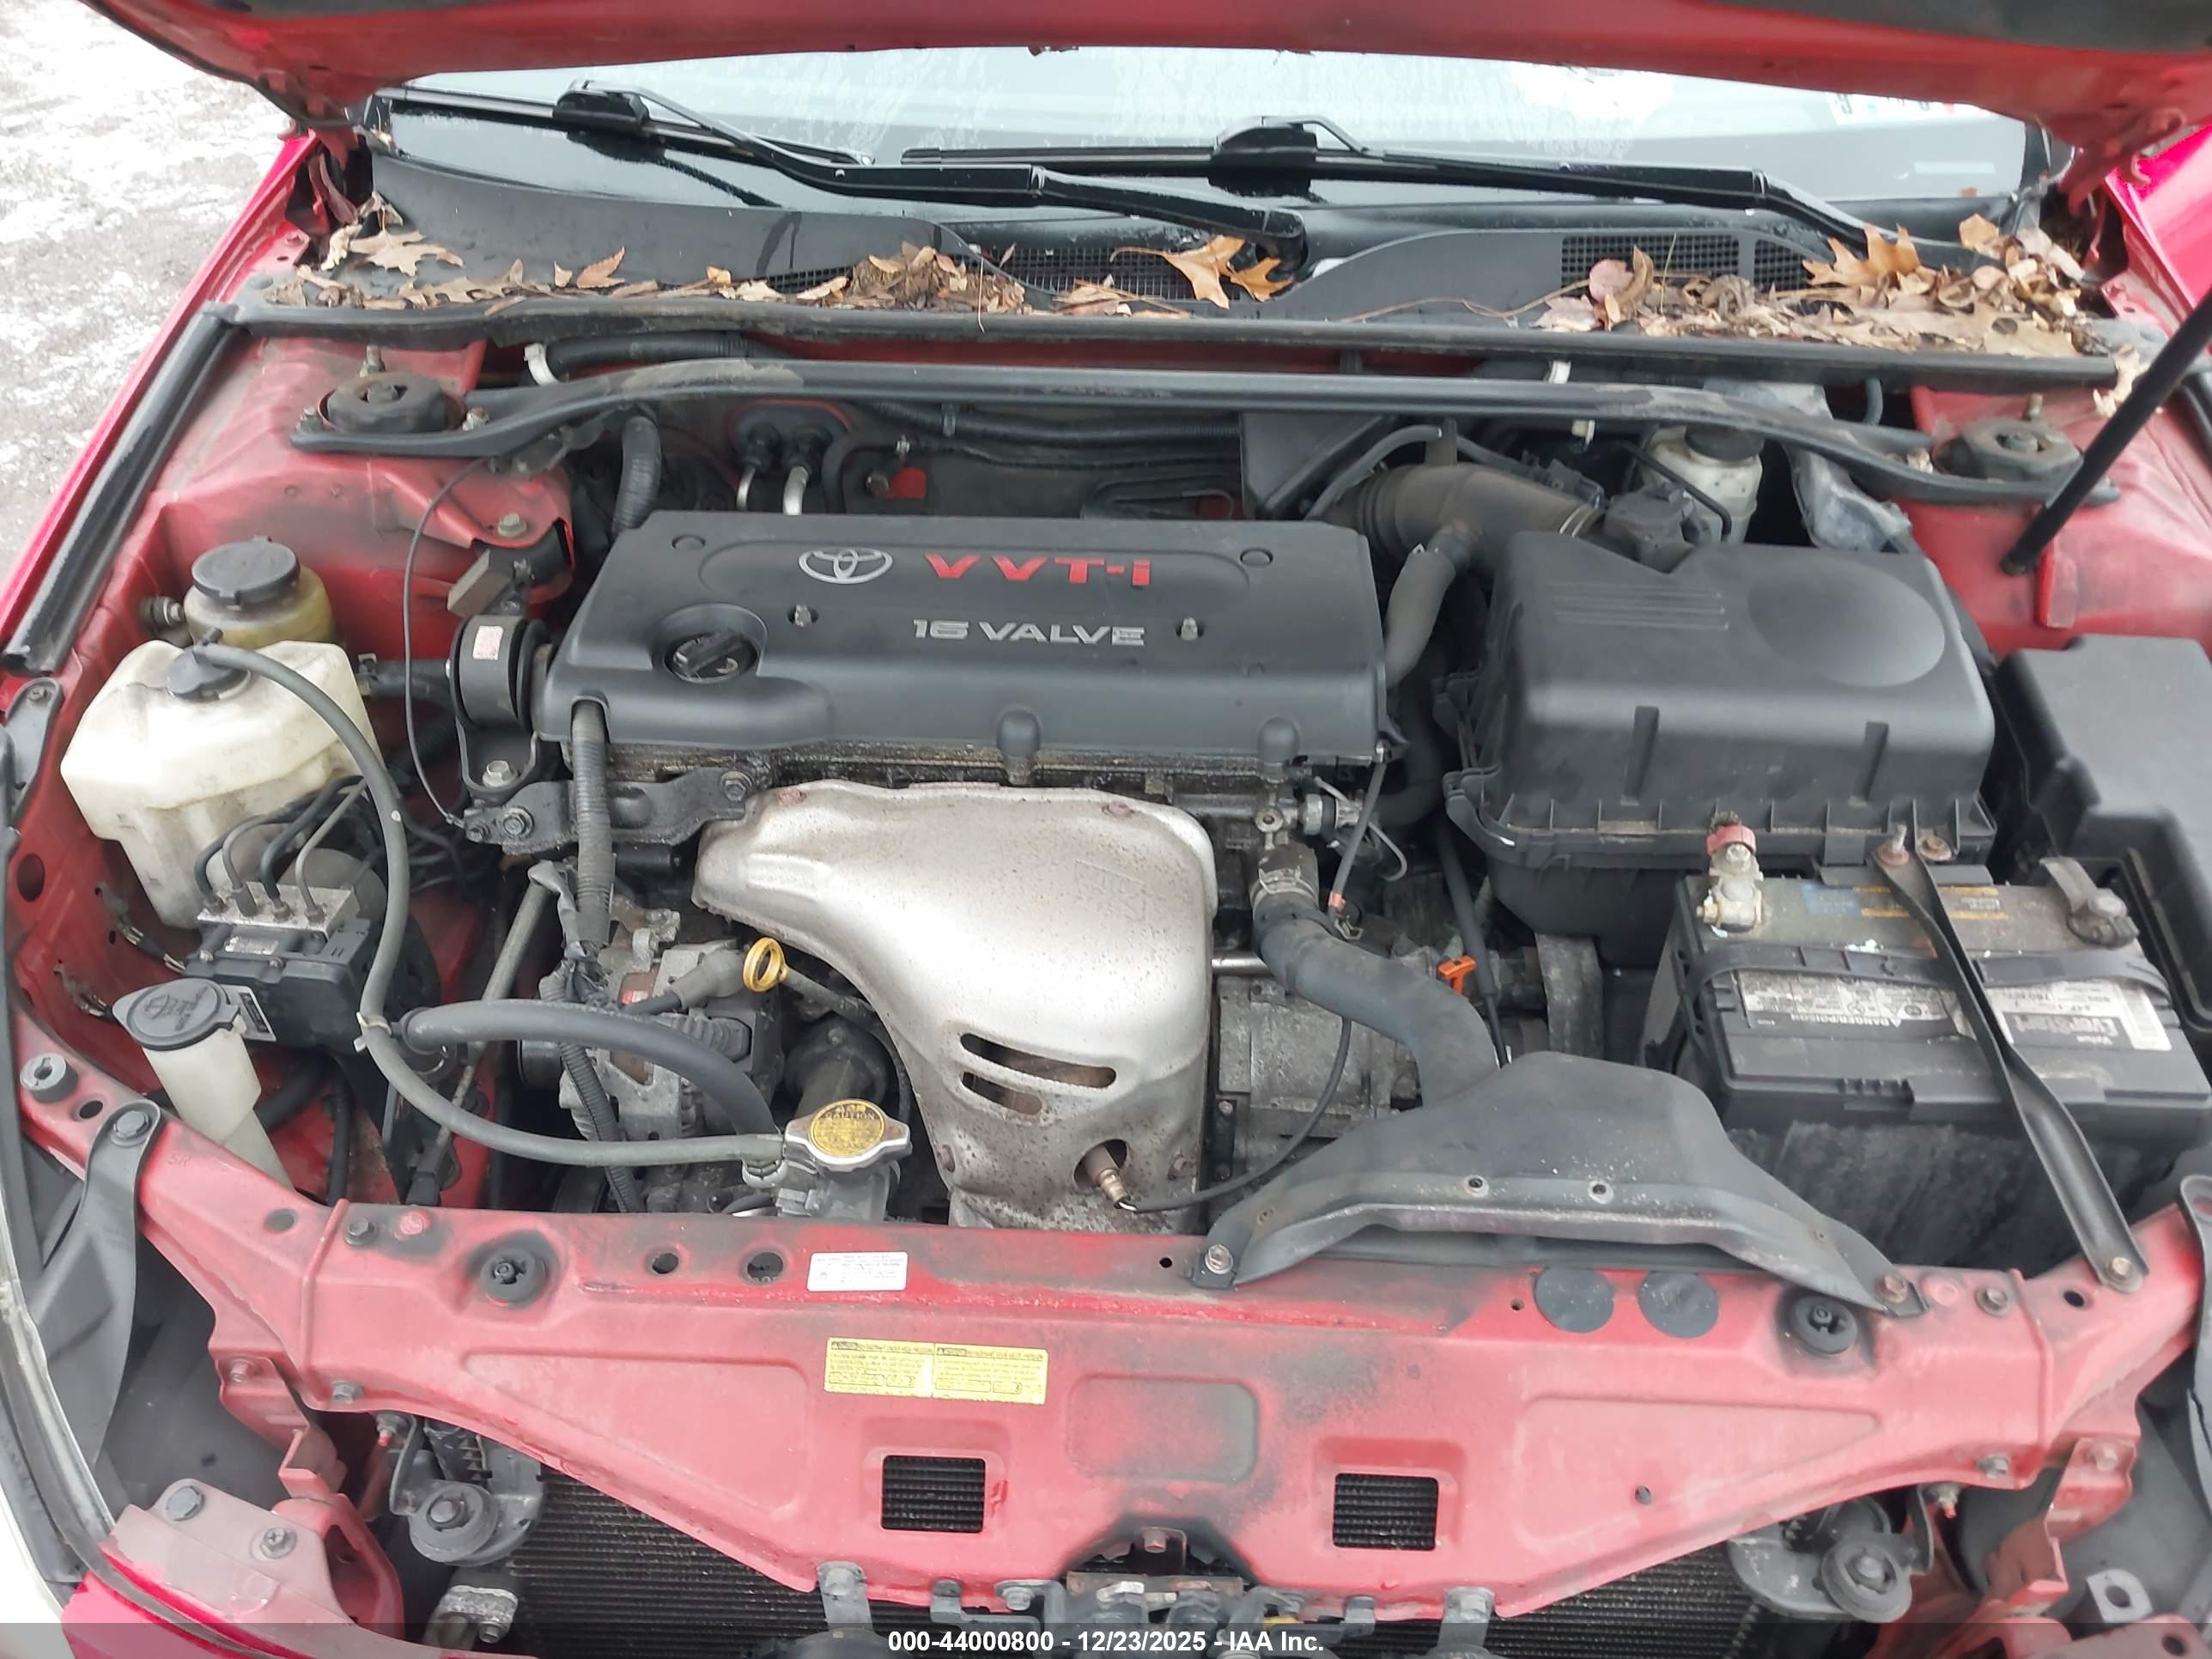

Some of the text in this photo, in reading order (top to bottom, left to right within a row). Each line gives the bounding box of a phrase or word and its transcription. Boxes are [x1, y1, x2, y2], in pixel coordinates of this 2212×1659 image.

[913, 618, 1146, 647] 16 VALVE
[825, 1112, 876, 1121] CAUTION
